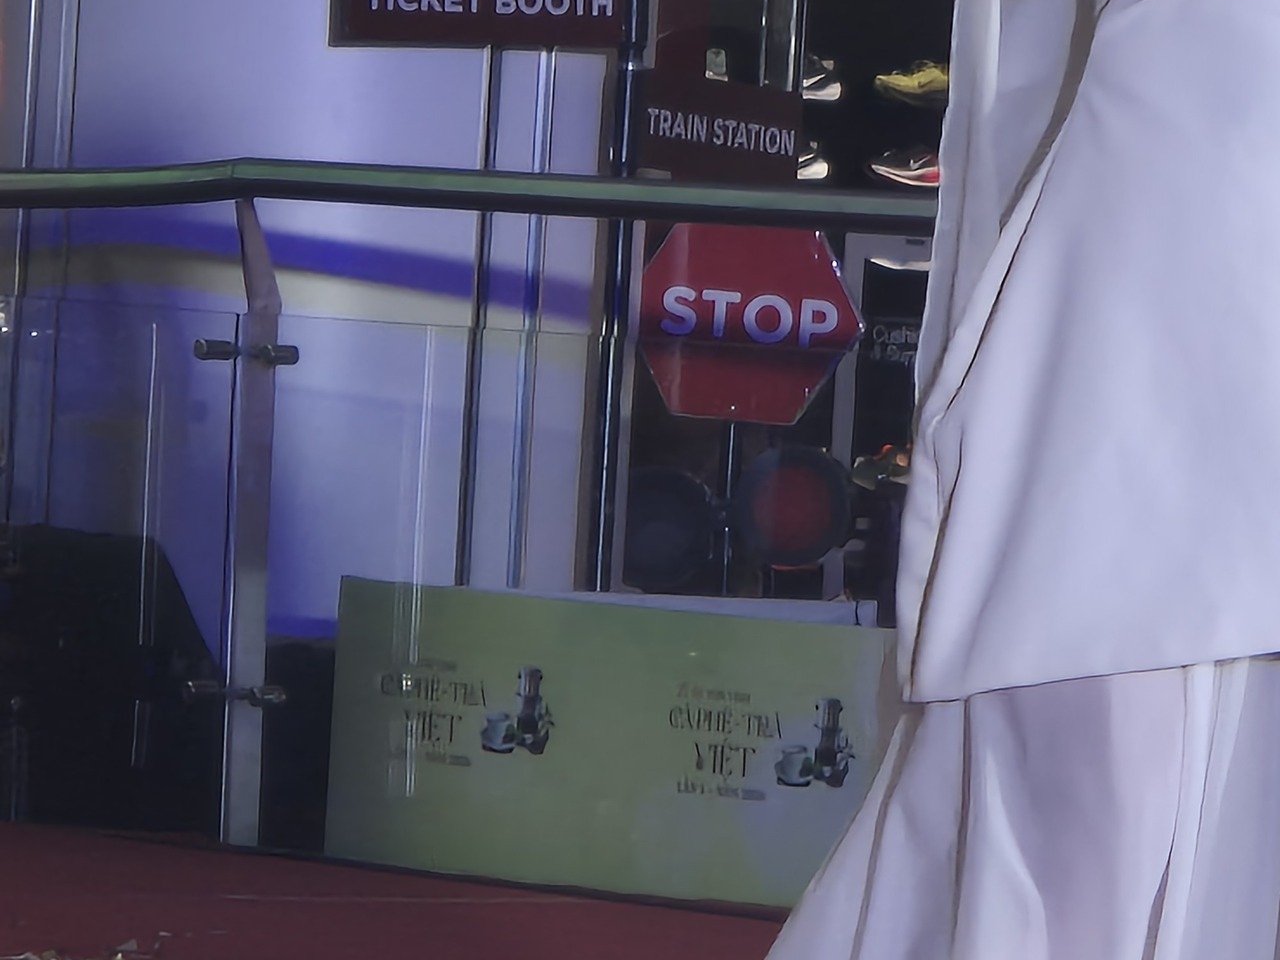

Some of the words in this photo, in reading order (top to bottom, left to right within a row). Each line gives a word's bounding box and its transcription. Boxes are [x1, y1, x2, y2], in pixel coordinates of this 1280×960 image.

[647, 107, 708, 143] TRAIN
[712, 117, 796, 157] STATION
[660, 285, 839, 348] STOP
